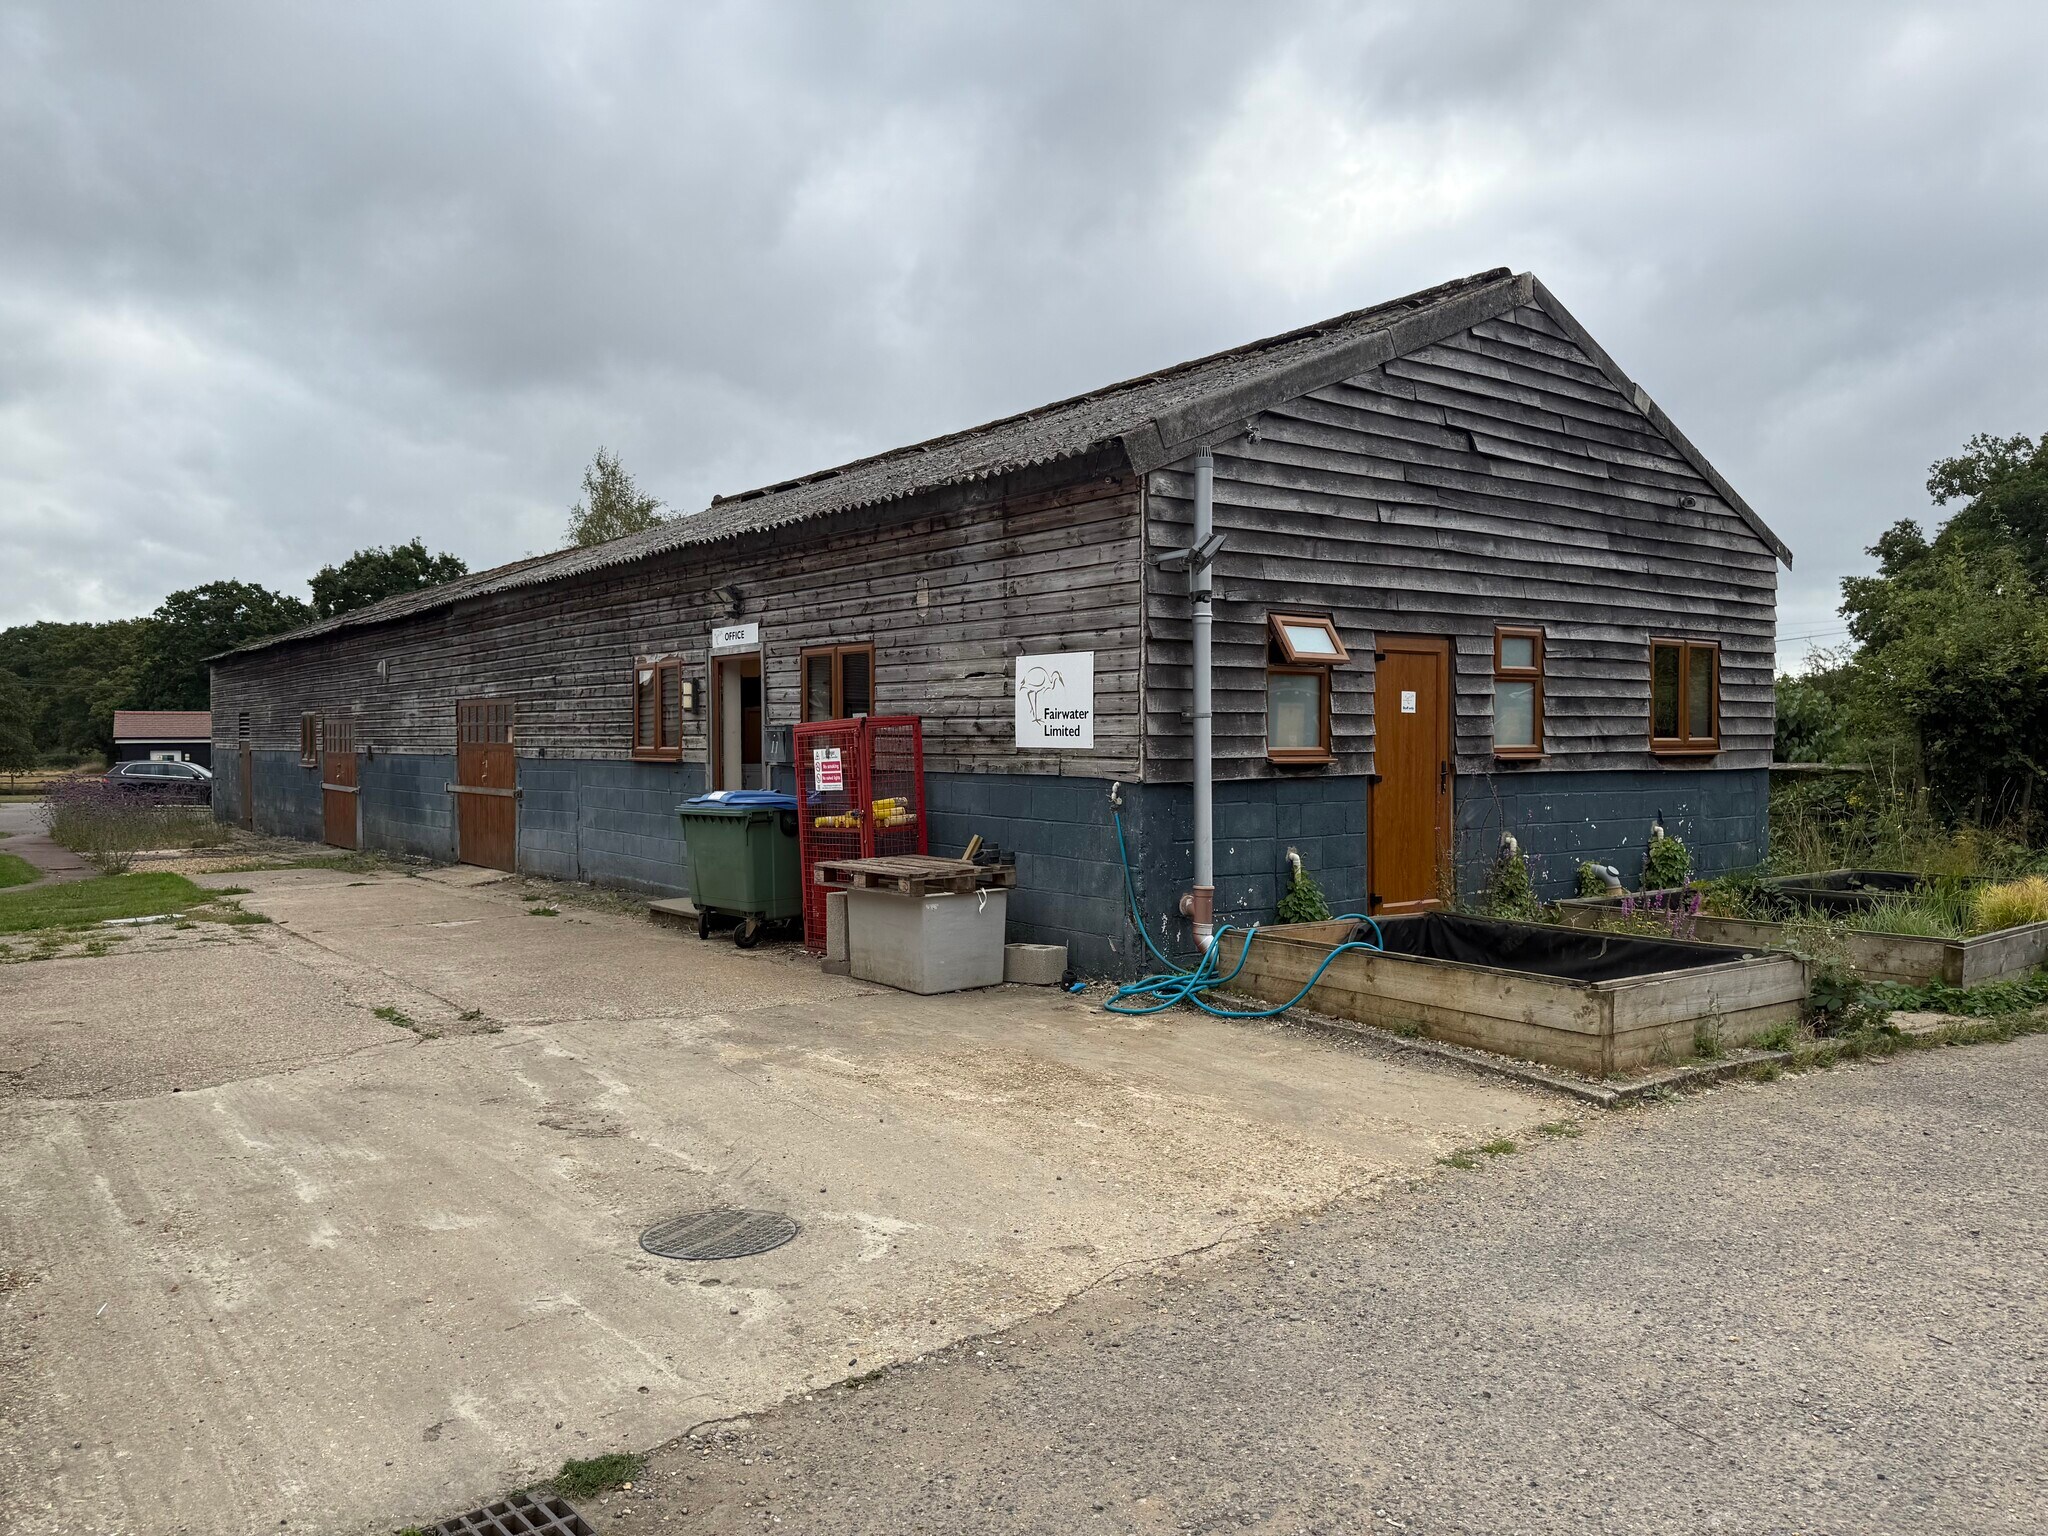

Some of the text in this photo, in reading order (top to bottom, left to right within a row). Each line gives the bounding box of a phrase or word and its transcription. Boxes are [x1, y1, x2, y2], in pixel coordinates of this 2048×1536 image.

[724, 630, 745, 641] OFFICE
[1044, 707, 1089, 720] Fairwater
[1044, 724, 1081, 737] Limited
